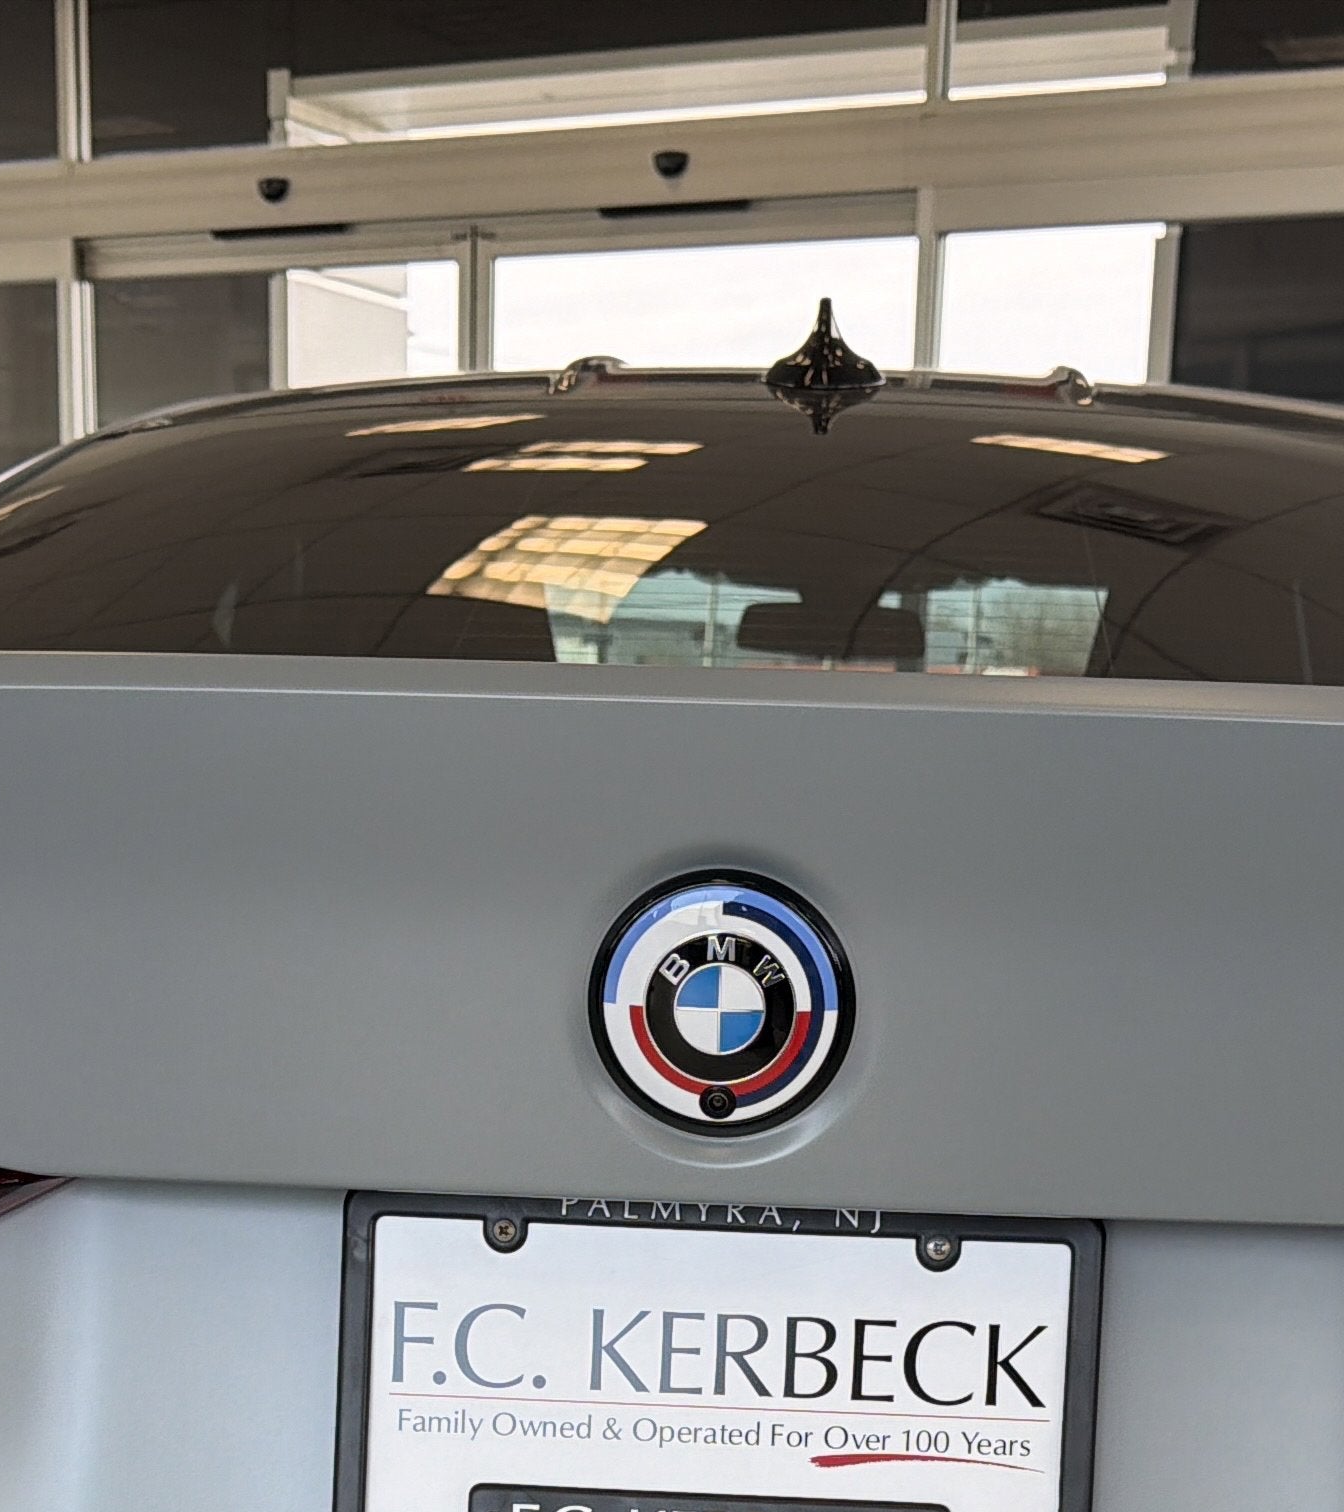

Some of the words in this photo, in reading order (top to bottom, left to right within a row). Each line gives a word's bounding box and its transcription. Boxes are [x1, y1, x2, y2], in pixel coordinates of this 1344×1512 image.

[658, 934, 786, 988] BMW
[834, 1208, 881, 1234] NJ
[389, 1300, 547, 1390] F.C.
[588, 1308, 1049, 1409] KERBECK
[398, 1408, 484, 1441] Family
[492, 1411, 592, 1440] Owned
[602, 1417, 622, 1441] &
[632, 1415, 760, 1449] Operated
[770, 1423, 813, 1448] For
[824, 1425, 891, 1452] Over
[902, 1429, 950, 1454] 100
[961, 1431, 1031, 1458] Years
